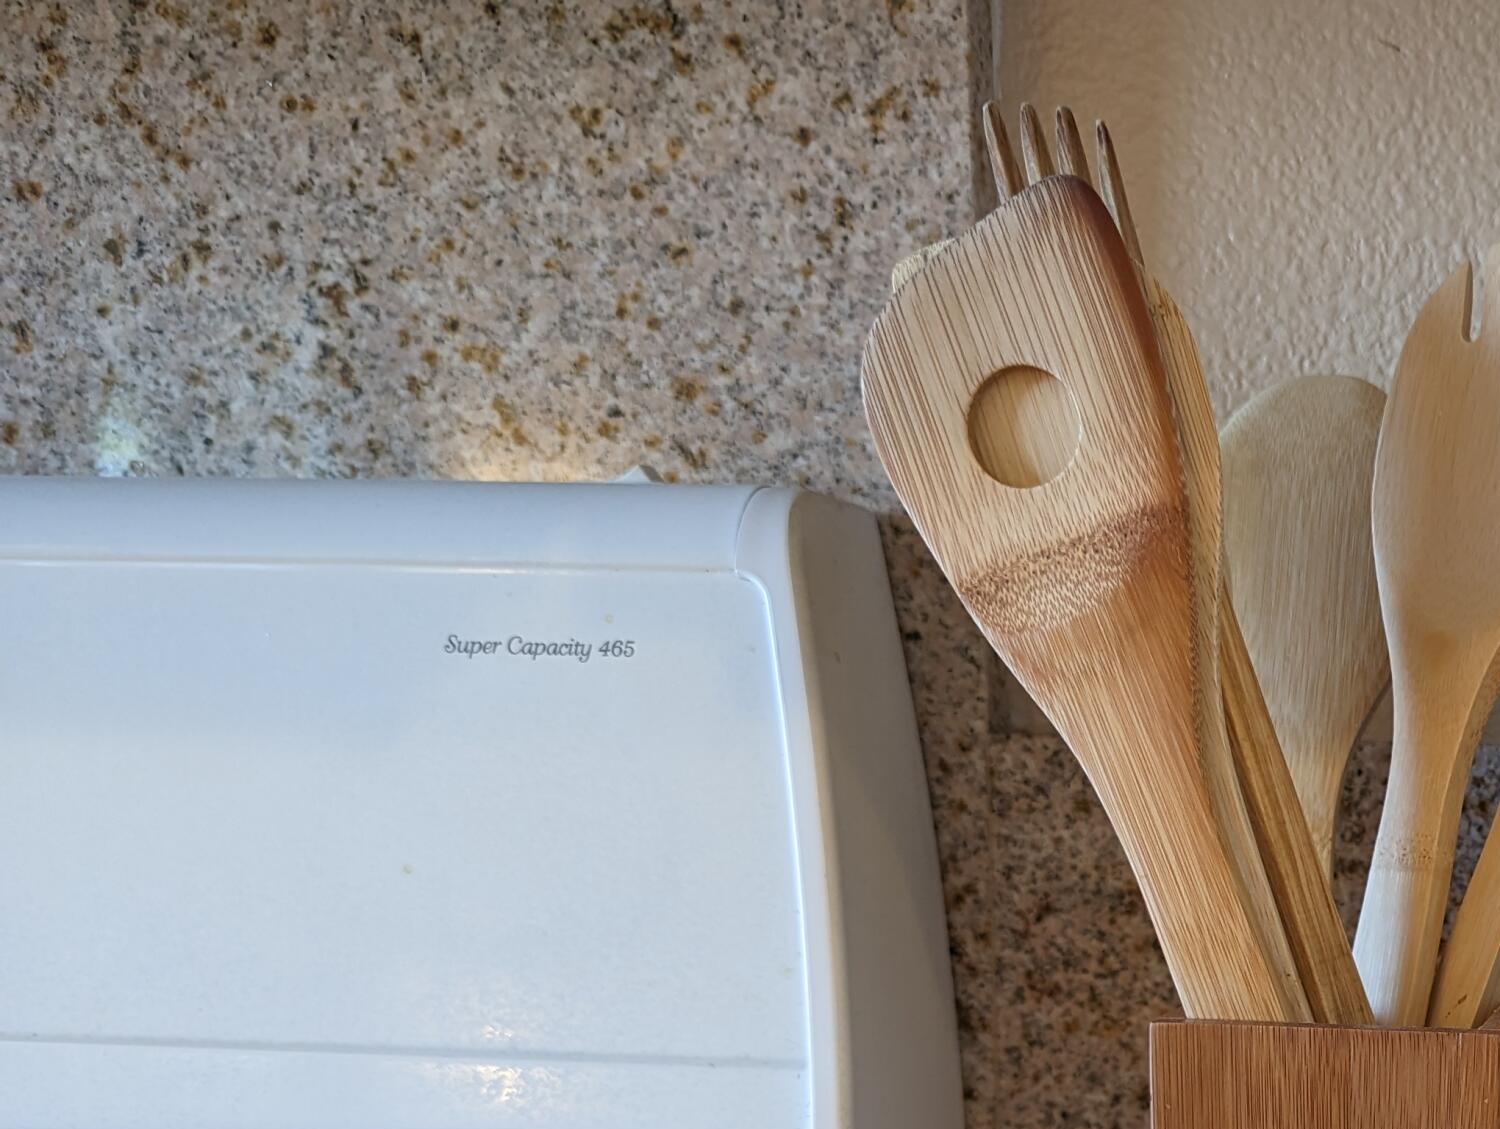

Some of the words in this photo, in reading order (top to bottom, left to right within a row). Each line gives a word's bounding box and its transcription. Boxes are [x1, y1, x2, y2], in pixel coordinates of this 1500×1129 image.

[444, 634, 501, 659] Super
[507, 635, 592, 663] Capacity
[598, 639, 636, 658] 465
